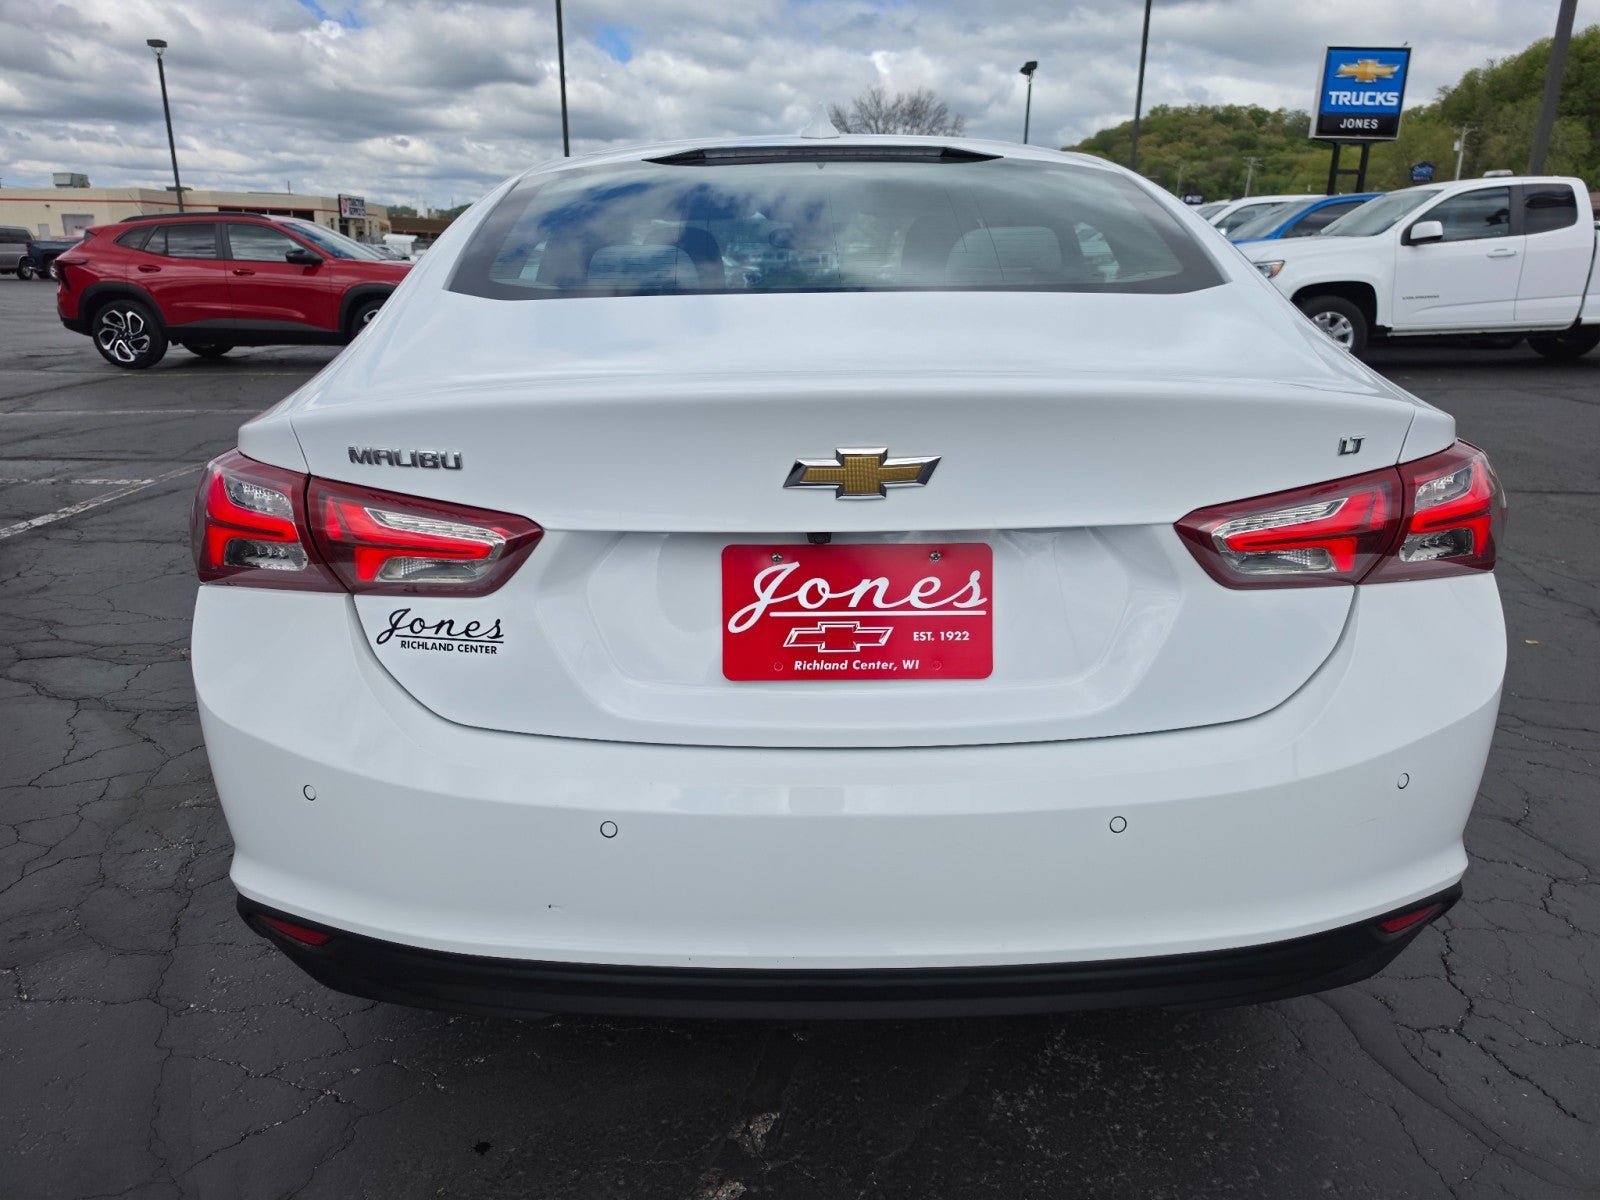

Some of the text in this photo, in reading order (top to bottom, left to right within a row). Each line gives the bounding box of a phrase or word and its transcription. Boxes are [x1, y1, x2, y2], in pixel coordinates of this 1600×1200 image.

[1328, 91, 1399, 106] TRUCKS
[1339, 118, 1379, 129] JONES
[1337, 436, 1366, 456] LT
[348, 446, 463, 470] MALIBU
[727, 561, 988, 634] Jones
[376, 608, 504, 645] Jones
[913, 631, 970, 641] EST. 1922
[400, 640, 497, 655] RICHLAND CENTER
[794, 659, 920, 671] Richland Center, WI
